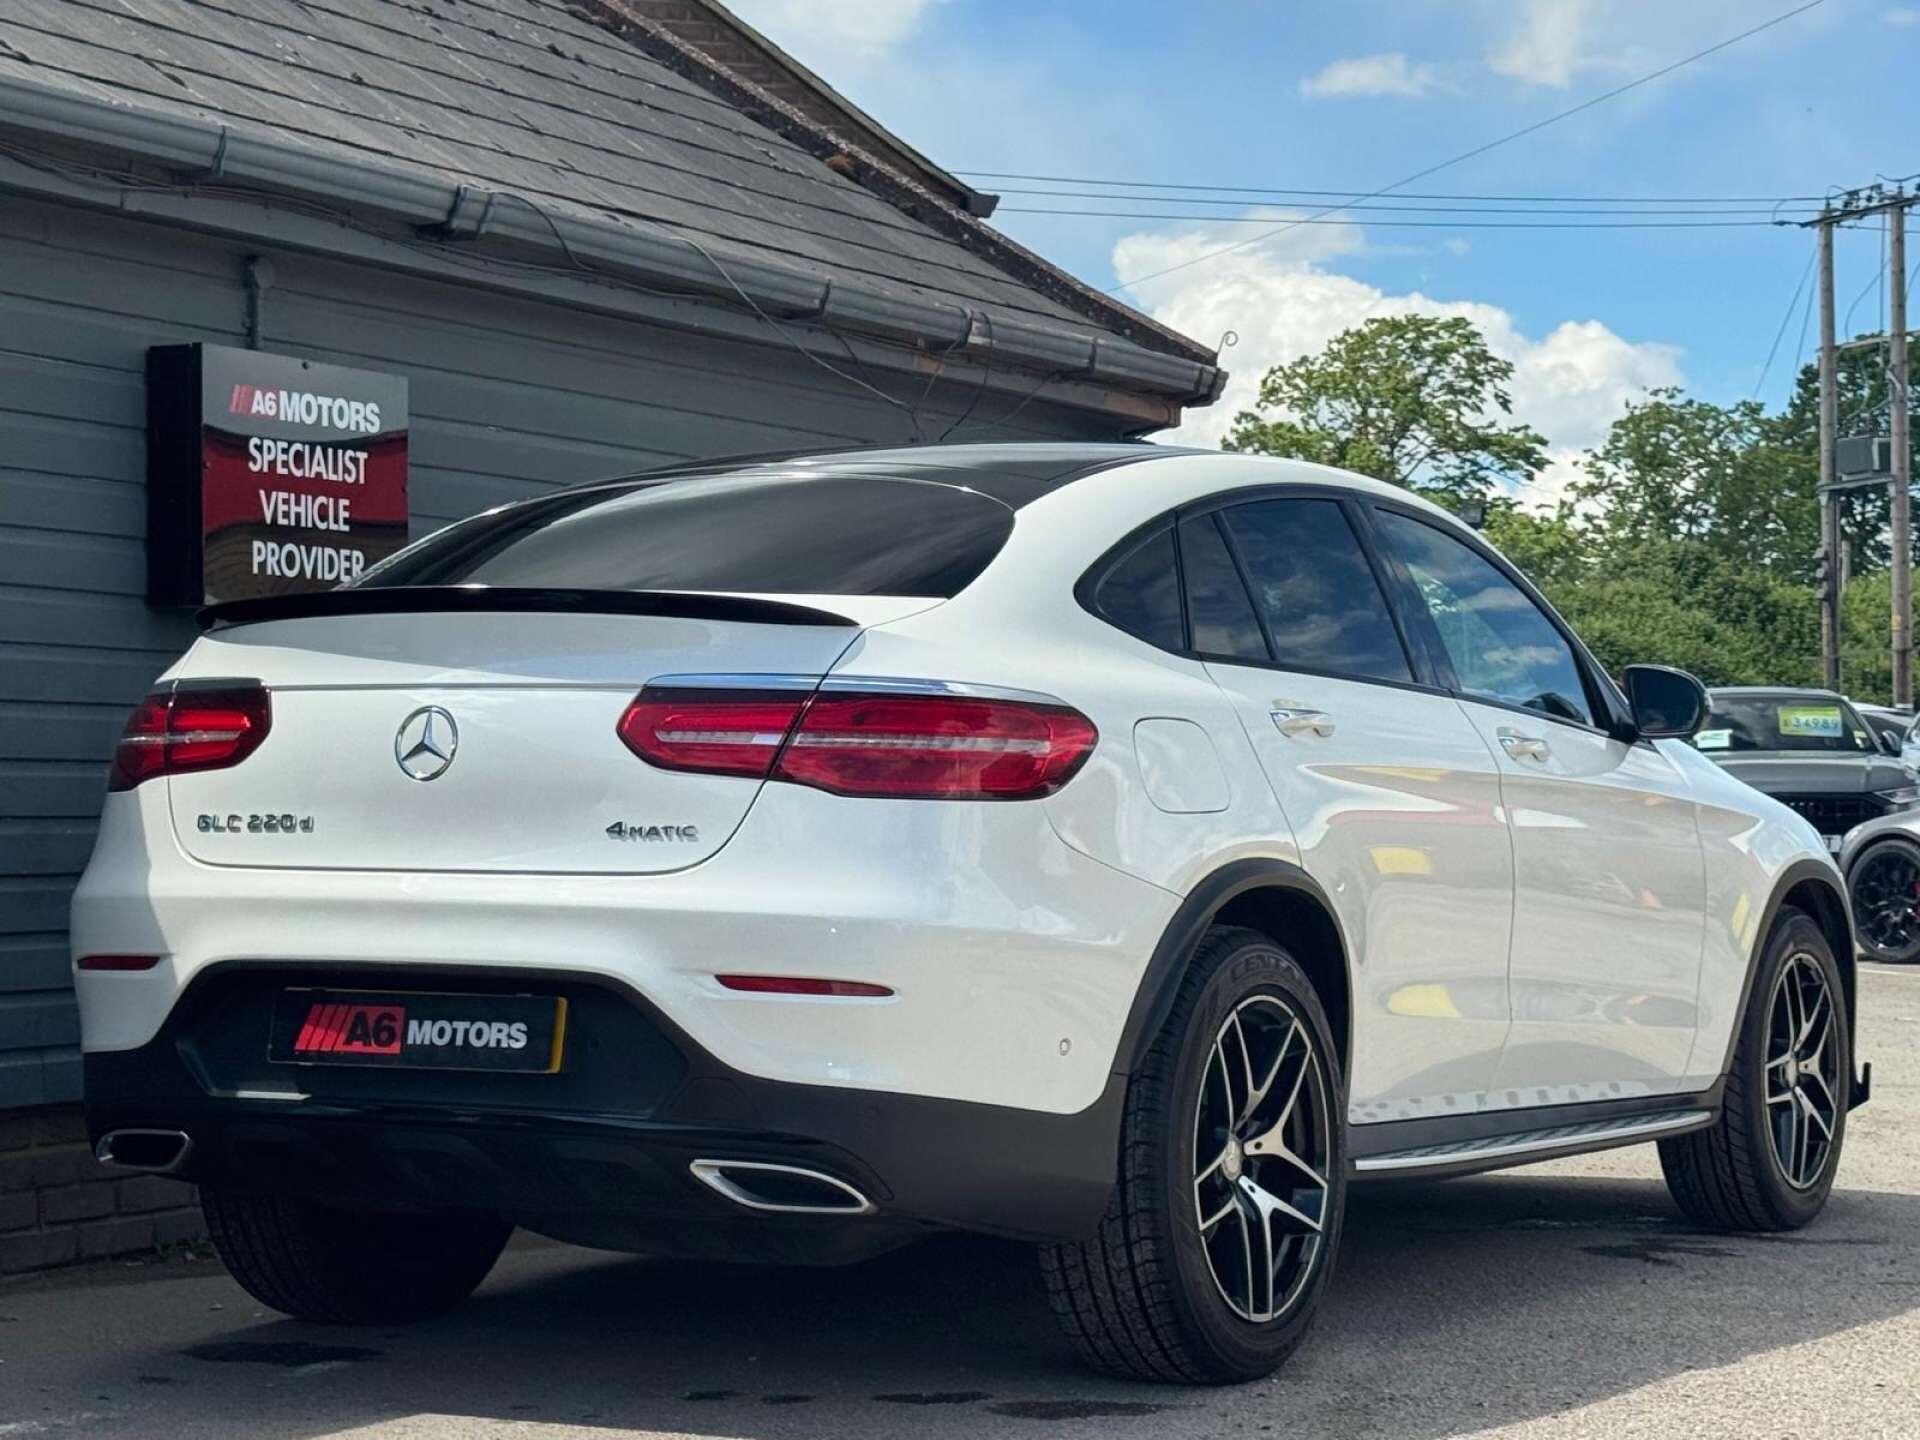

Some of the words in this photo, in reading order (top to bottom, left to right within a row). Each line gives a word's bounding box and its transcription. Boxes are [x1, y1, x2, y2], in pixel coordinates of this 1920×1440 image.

[251, 389, 277, 416] A6
[279, 390, 381, 433] MOTORS
[248, 437, 368, 484] SPECIALIST
[259, 489, 350, 532] VEHICLE
[252, 540, 365, 582] PROVIDER
[197, 814, 242, 833] GLC
[344, 1010, 397, 1047] A6
[407, 1019, 528, 1049] MOTORS
